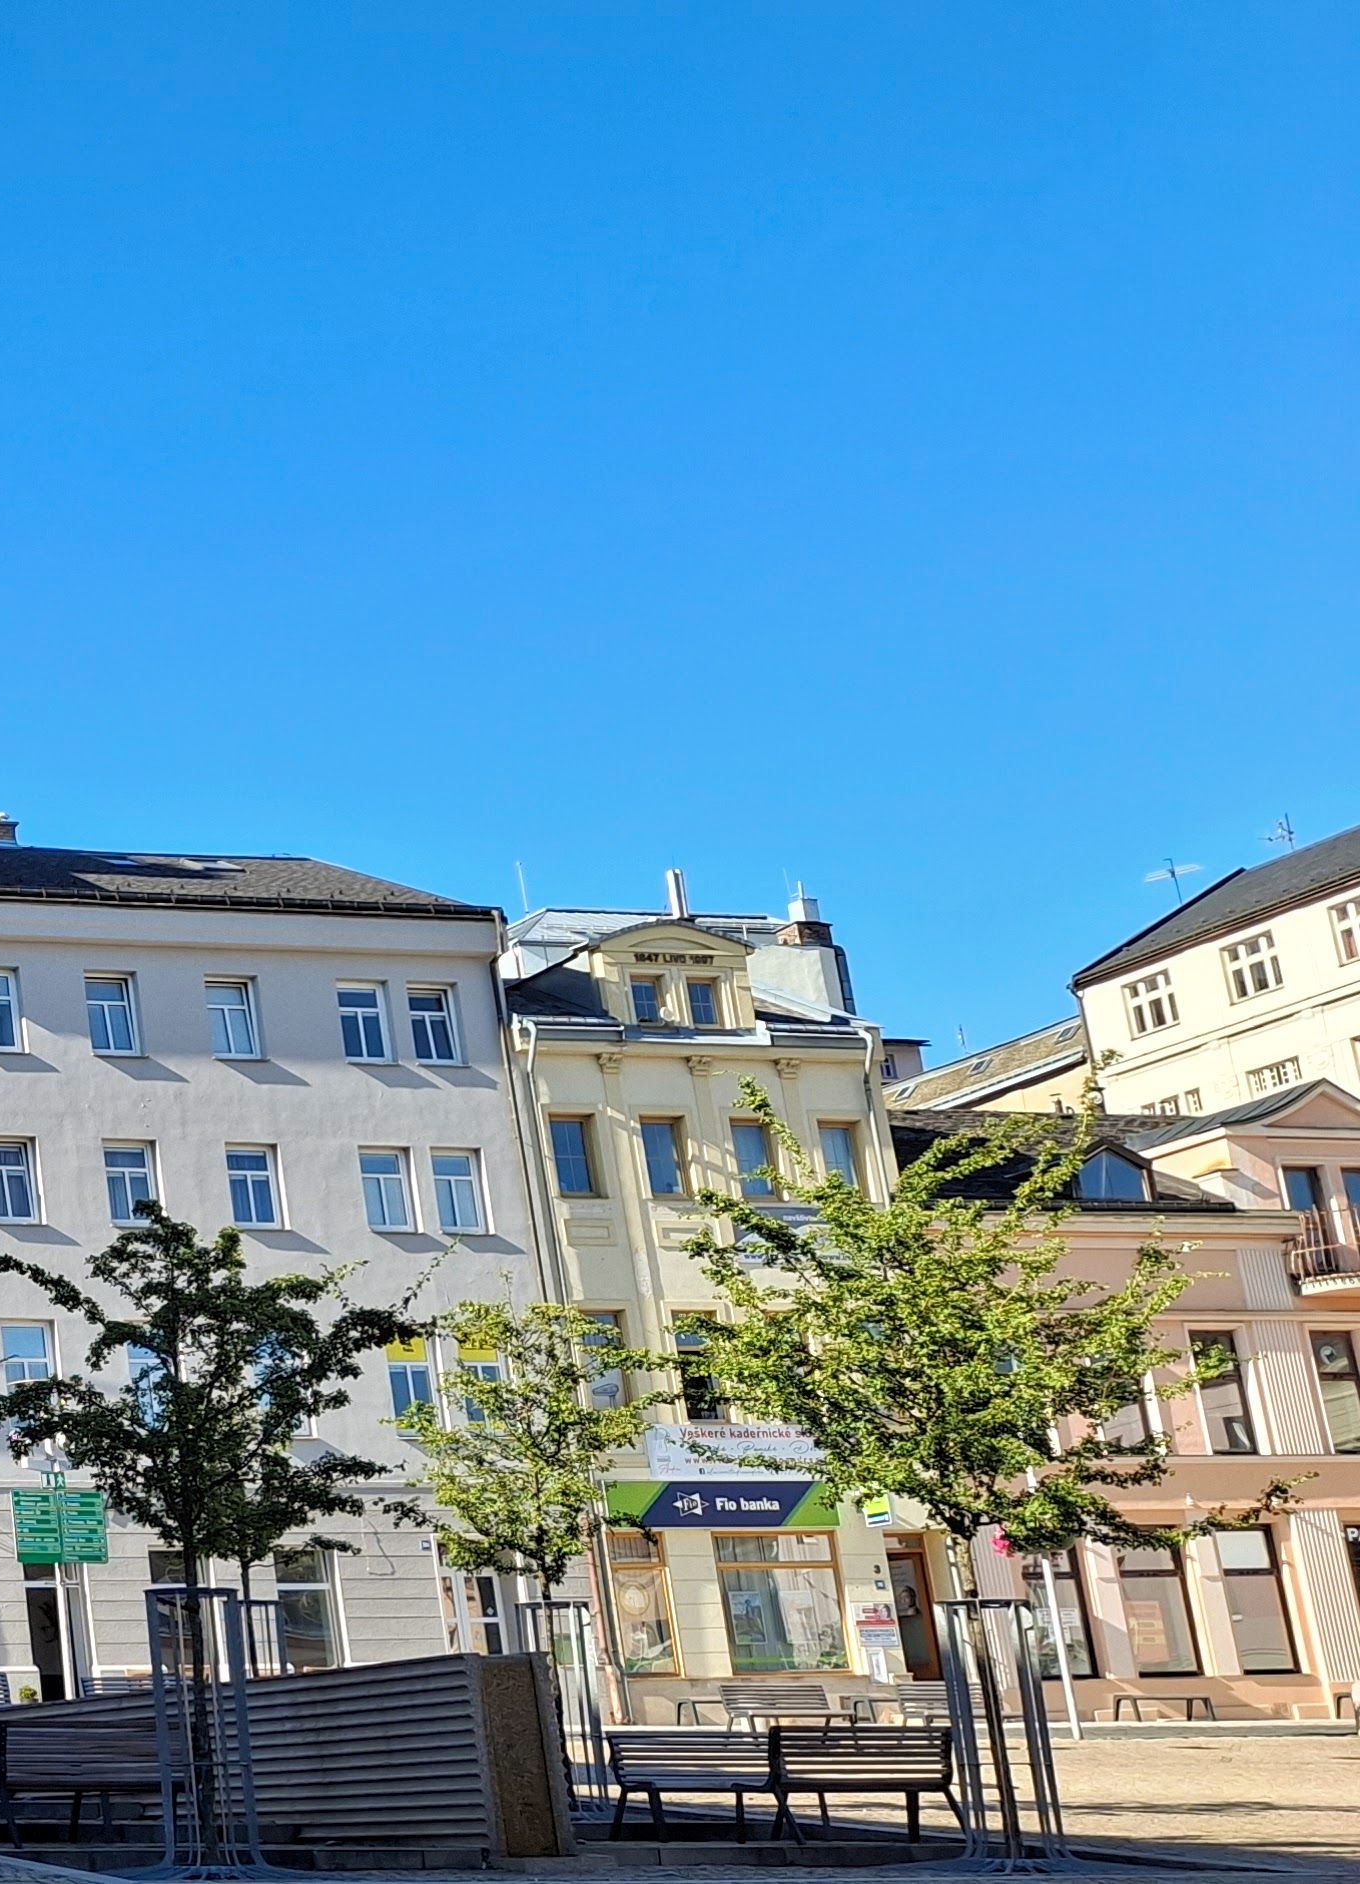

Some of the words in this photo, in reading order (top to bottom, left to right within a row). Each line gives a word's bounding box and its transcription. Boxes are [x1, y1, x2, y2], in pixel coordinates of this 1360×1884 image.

[715, 1498, 737, 1511] Fio
[741, 1497, 780, 1511] banka
[873, 1564, 881, 1574] 3
